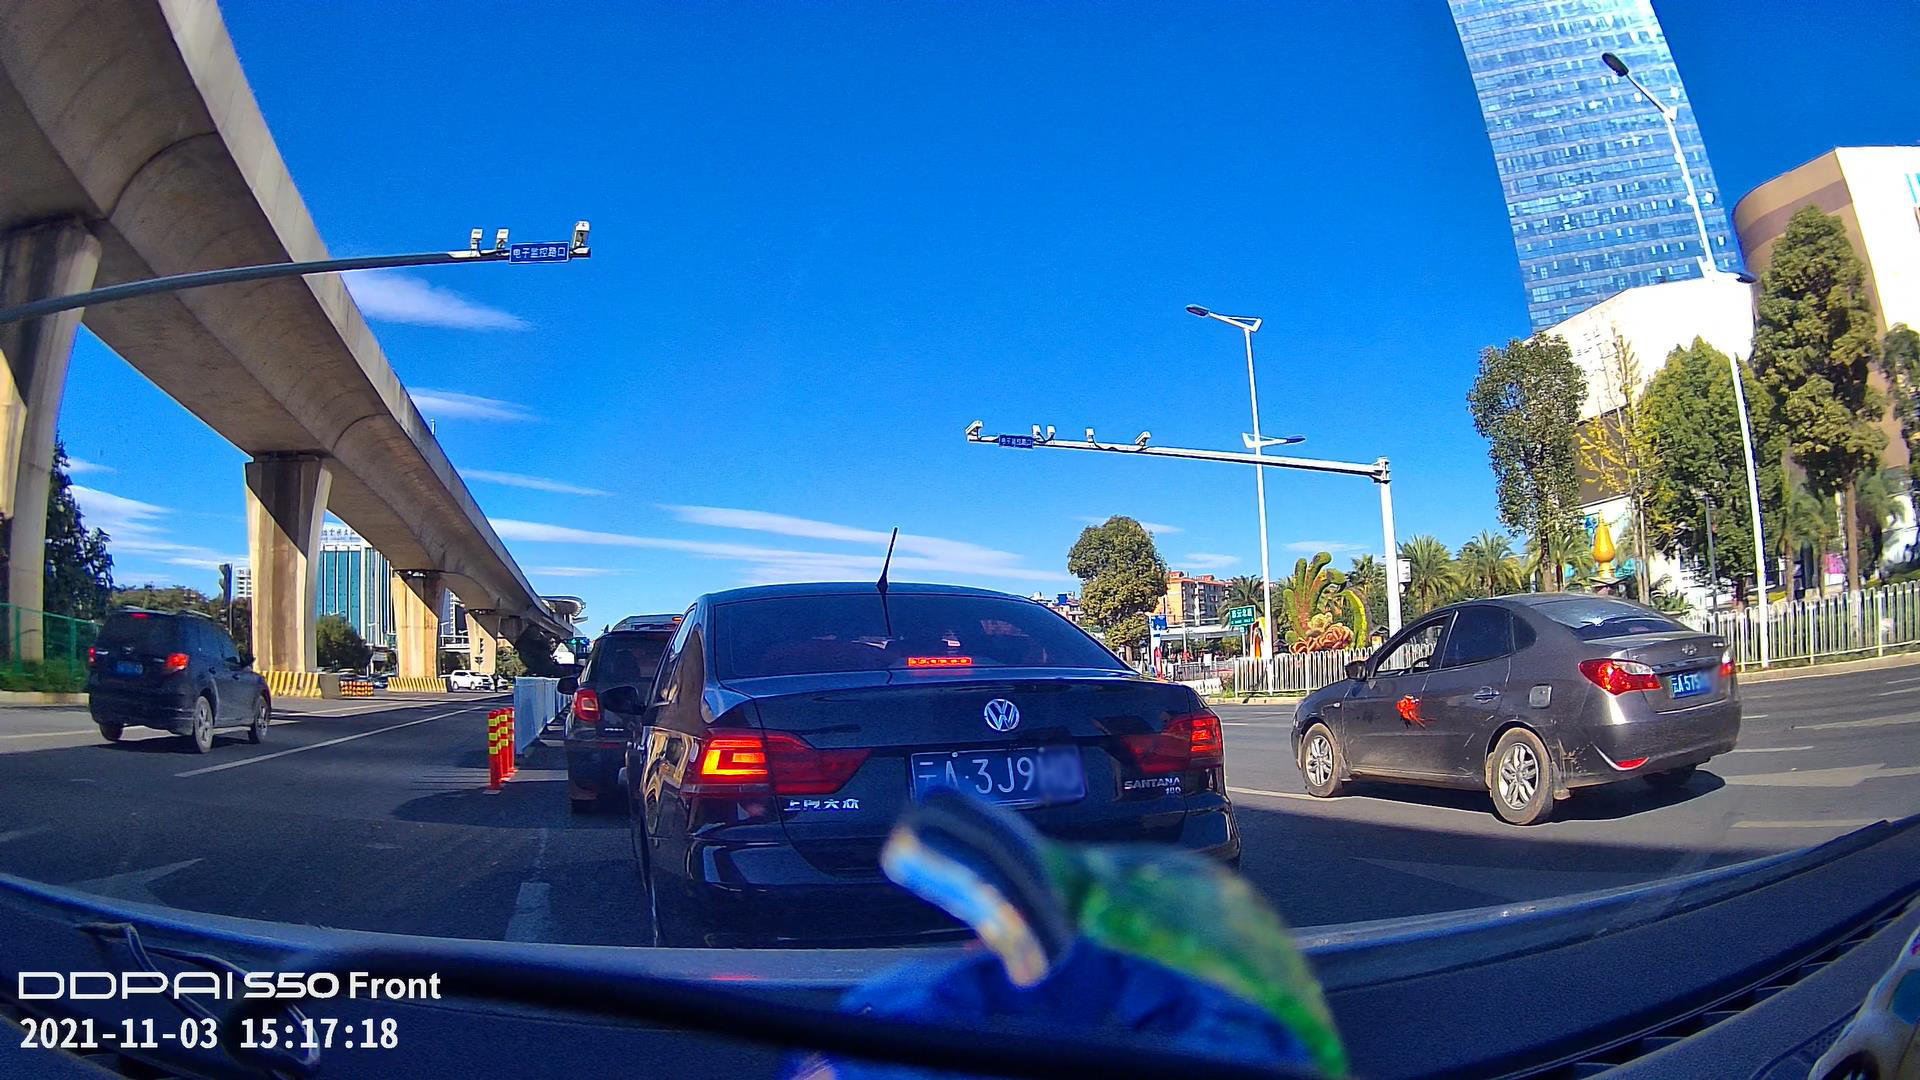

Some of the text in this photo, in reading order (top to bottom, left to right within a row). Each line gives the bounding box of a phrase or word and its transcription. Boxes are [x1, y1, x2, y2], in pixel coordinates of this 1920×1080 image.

[513, 246, 566, 259] 电子监控路口
[1124, 777, 1180, 789] SANTANA
